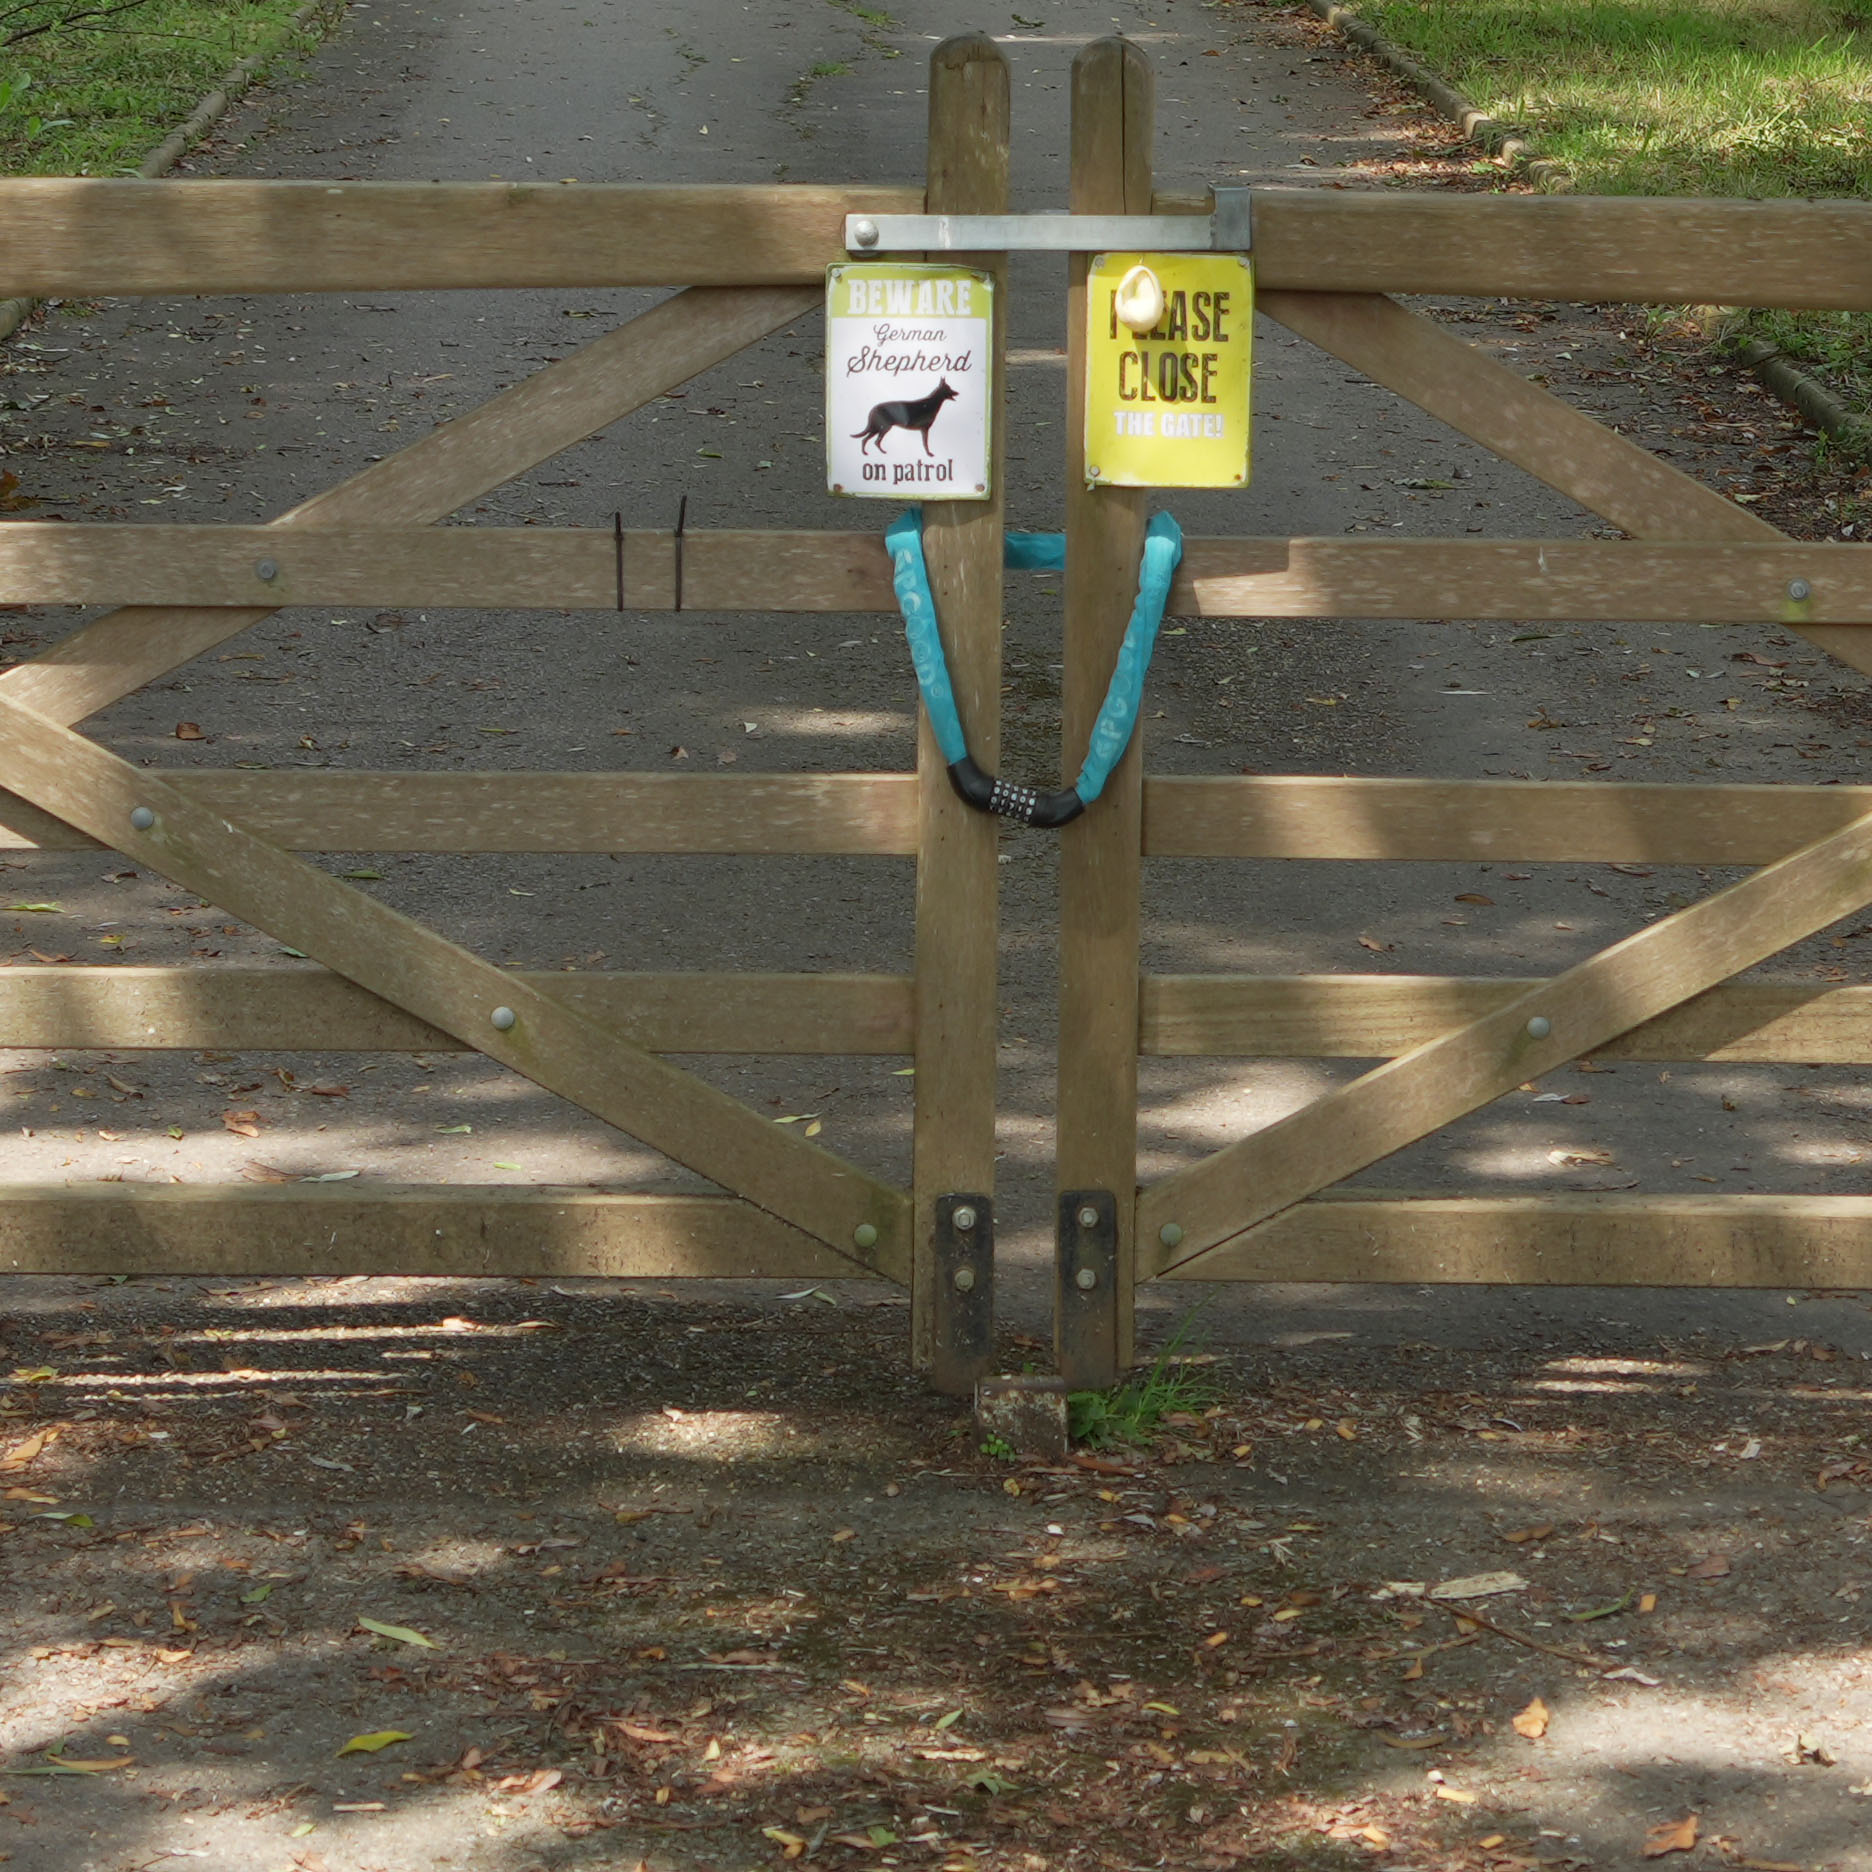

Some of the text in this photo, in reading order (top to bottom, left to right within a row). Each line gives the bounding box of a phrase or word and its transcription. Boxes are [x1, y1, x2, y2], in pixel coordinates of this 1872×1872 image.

[847, 279, 972, 315] BEWARE
[873, 323, 947, 347] German
[846, 345, 973, 377] Shepherd
[1119, 351, 1218, 403] CLOSE
[1113, 412, 1225, 438] THE GATE!
[862, 459, 953, 485] on patrol
